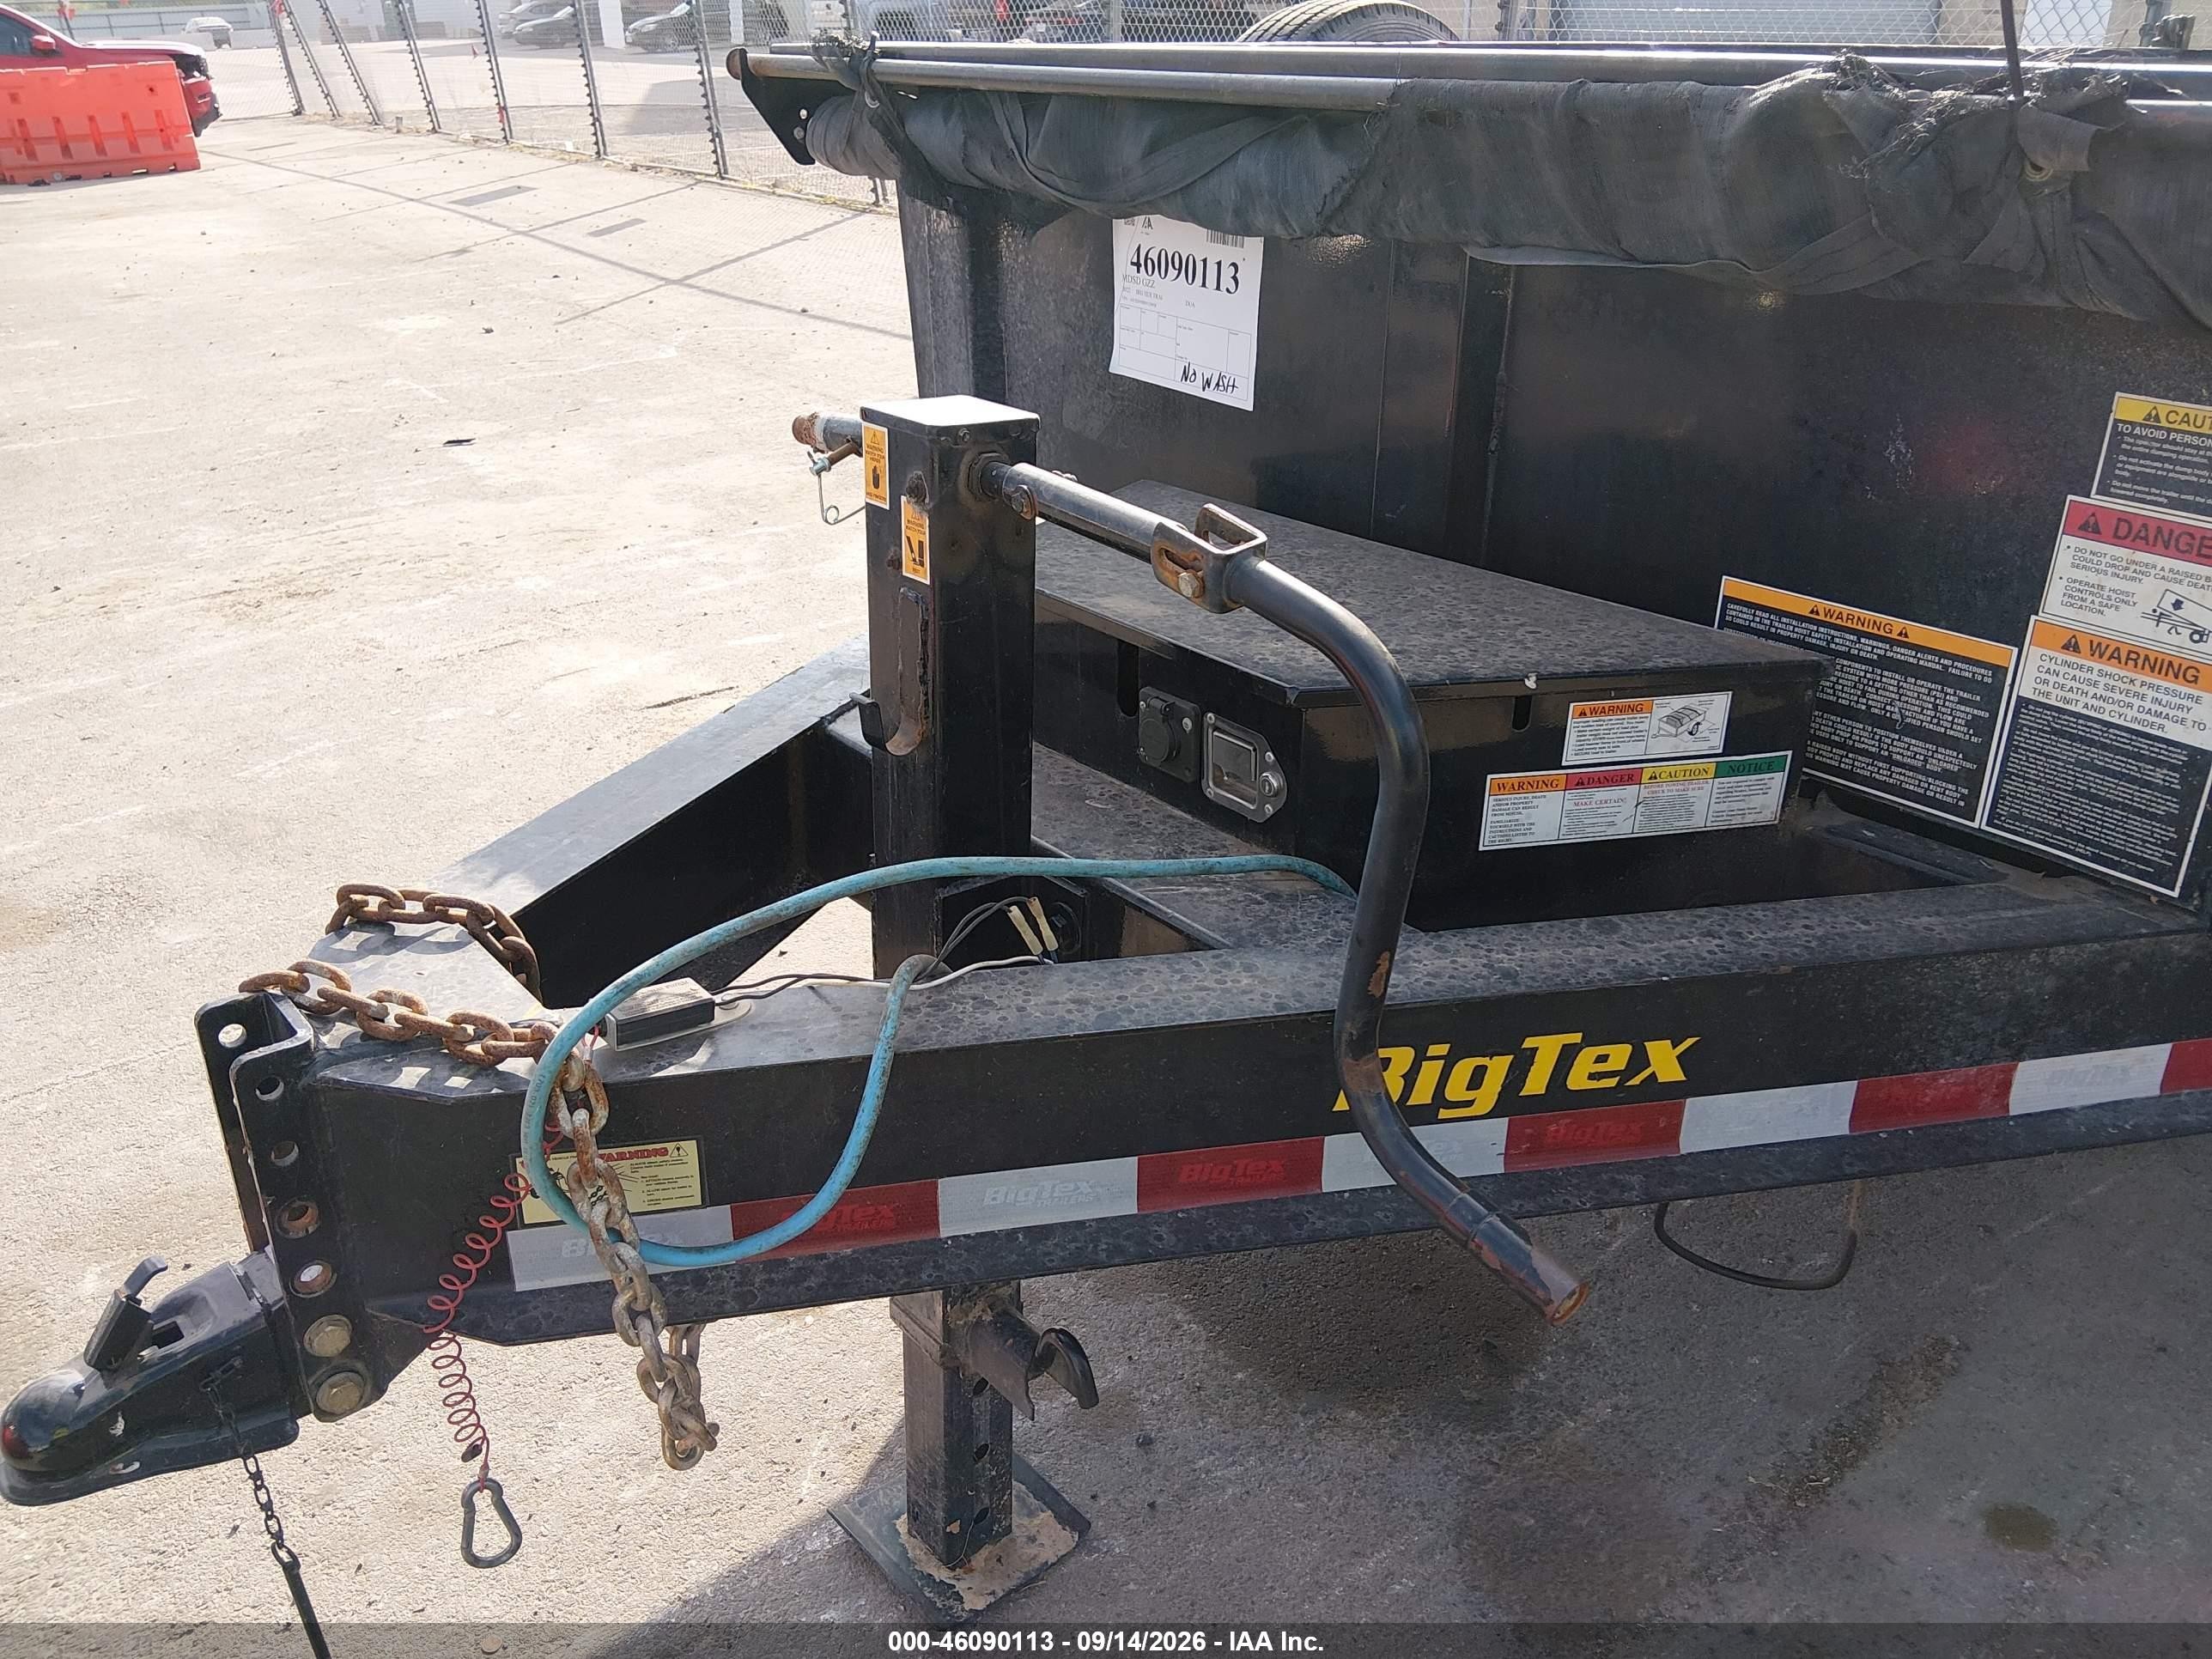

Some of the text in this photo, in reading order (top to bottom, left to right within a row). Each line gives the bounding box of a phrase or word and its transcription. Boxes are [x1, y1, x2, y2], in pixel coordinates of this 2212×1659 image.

[1130, 244, 1239, 294] 46090113
[1201, 372, 1238, 394] WASH
[2117, 423, 2131, 434] TO
[2133, 427, 2167, 440] AVOID
[2069, 561, 2143, 585] SERIOUS INJURY.
[2071, 554, 2103, 567] COULD
[2104, 561, 2130, 574] DROP
[2131, 567, 2150, 578] AND
[2153, 572, 2185, 586] CAUSE
[2186, 579, 2212, 592] DEAT
[2073, 546, 2088, 556] DO
[2089, 550, 2107, 560] NOT
[2110, 554, 2124, 563] GO
[2125, 557, 2157, 571] UNDER
[2167, 567, 2202, 580] RAISED
[2062, 592, 2121, 612] FROM A SAFE
[2063, 584, 2138, 608] CONTROLS ONLY
[2066, 576, 2136, 599] OPERATE HOIST
[1821, 606, 1894, 635] WARNING
[2060, 599, 2106, 617] LOCATION.
[1726, 609, 1753, 621] CONTAINED
[1771, 621, 1793, 631] TRAILER
[1794, 627, 1810, 635] HOIST
[1833, 637, 1872, 652] INSTALLATION
[1873, 647, 1884, 655] AND
[1885, 650, 1918, 664] OPERATING
[1948, 666, 1972, 678] FAILURE
[1727, 603, 1754, 615] CAREFULLY
[1754, 610, 1769, 618] READ
[1780, 617, 1817, 630] INSTALLATION
[1893, 645, 1916, 656] DANGER
[1916, 651, 1939, 662] ALERTS
[1940, 657, 1952, 665] AND
[1953, 660, 1992, 677] PROCEDURES
[1733, 617, 1749, 626] COULD
[1750, 622, 1768, 631] RESULT
[1776, 629, 1803, 641] PROPERTY
[1829, 642, 1849, 653] INJURY
[2085, 639, 2203, 685] WARNING
[2036, 664, 2193, 715] CAN CAUSE SEVERE INJURY
[2039, 653, 2204, 705] CYLINDER SHOCK PRESSURE
[1588, 702, 1644, 716] WARNING
[2030, 686, 2169, 734] THE UNIT AND CYLINDER.
[2033, 675, 2207, 732] OR DEATH AND/OR DAMAGE TO
[1586, 772, 1635, 785] DANGER
[1658, 767, 1709, 779] CAUTION
[1727, 762, 1774, 774] NOTICE
[1496, 778, 1559, 793] WARNING
[1331, 1031, 1702, 1120] BigTex
